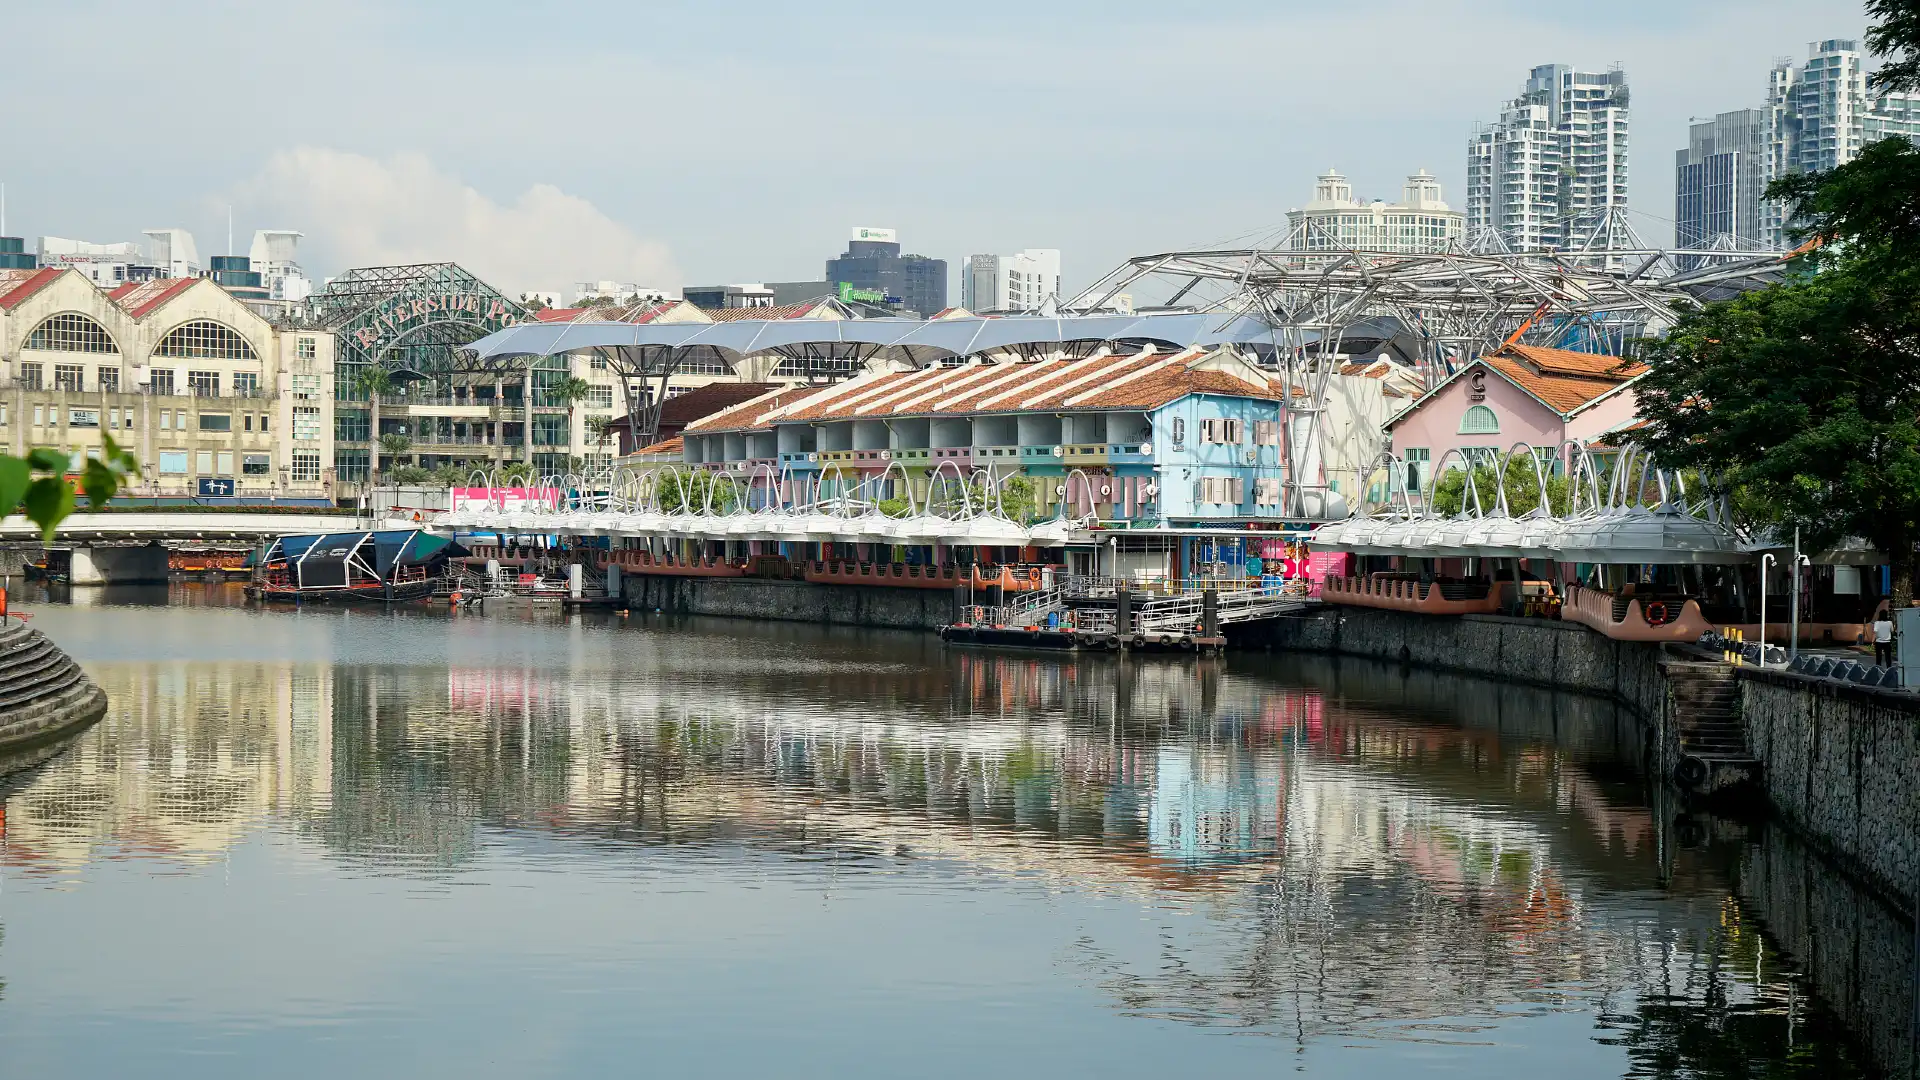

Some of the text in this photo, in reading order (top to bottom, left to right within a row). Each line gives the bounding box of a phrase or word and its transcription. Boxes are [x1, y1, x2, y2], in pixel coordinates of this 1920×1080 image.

[60, 254, 90, 263] Seacare
[355, 294, 479, 350] RIVERSIDE
[1471, 370, 1486, 391] C
